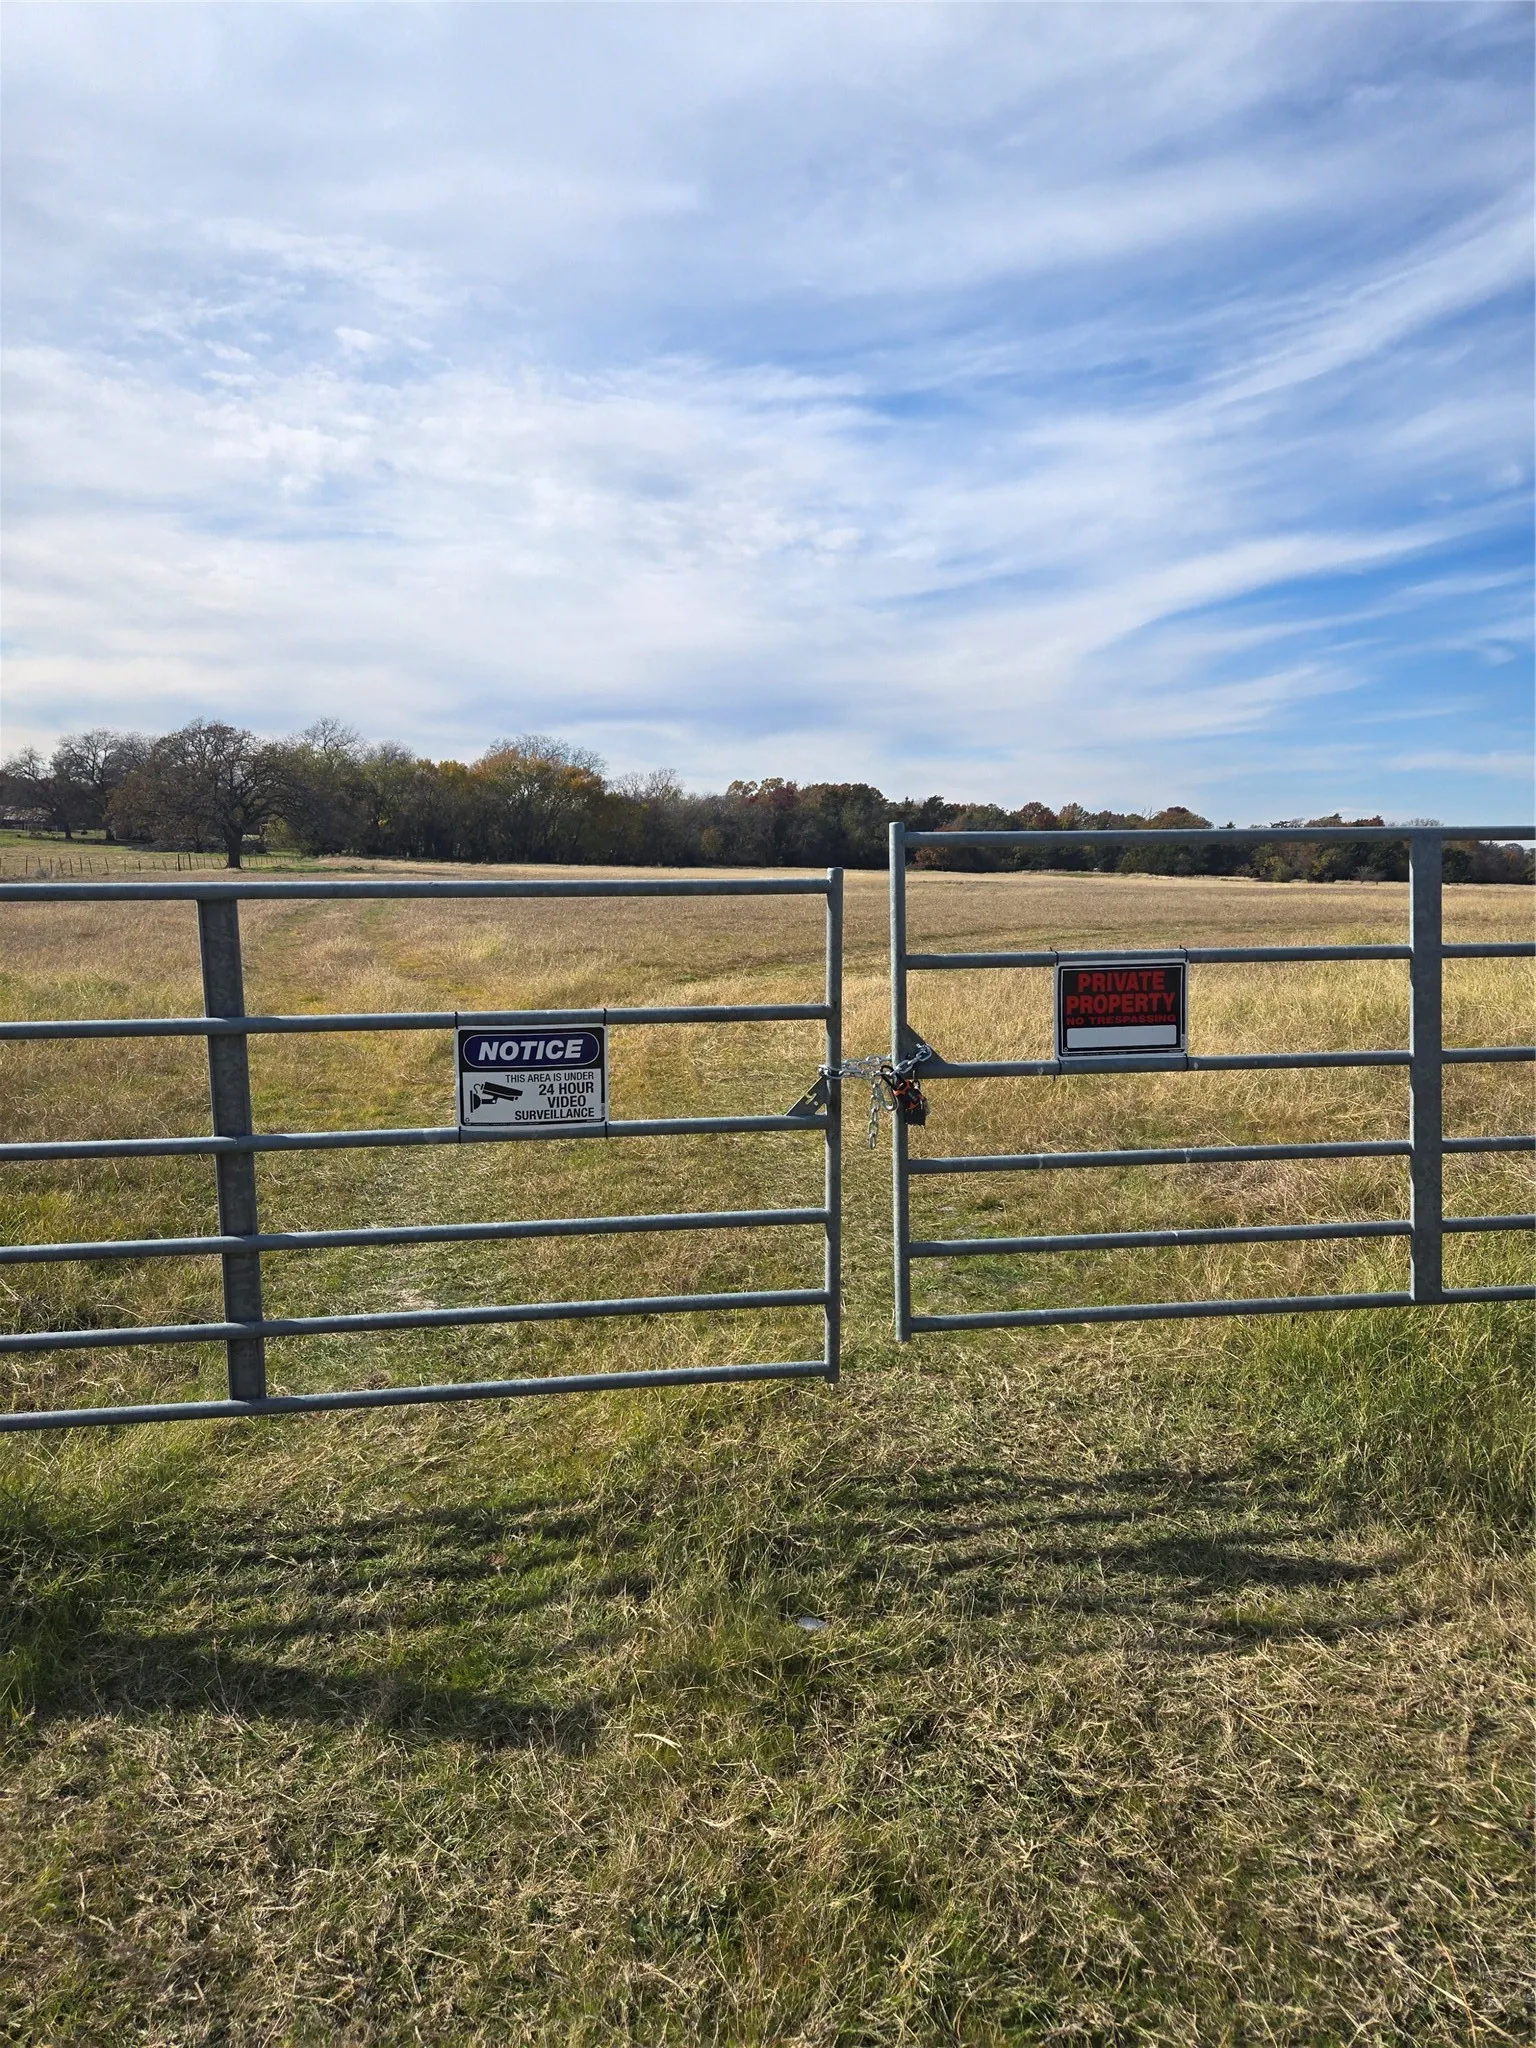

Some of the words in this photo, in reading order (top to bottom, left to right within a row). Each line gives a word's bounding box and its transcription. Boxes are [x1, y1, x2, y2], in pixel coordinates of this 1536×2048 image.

[1078, 971, 1165, 992] PRIVATE
[1066, 992, 1175, 1014] PROPERTY
[1067, 1016, 1085, 1025] NO
[1089, 1014, 1176, 1024] TRESPASSING
[478, 1039, 583, 1061] NOTICE
[505, 1074, 525, 1083] THIS
[527, 1073, 550, 1083] AREA
[553, 1072, 562, 1081] IS
[564, 1071, 594, 1081] UNDER
[538, 1083, 554, 1096] 24
[559, 1082, 594, 1095] HOUR
[547, 1095, 586, 1108] VIDEO
[514, 1108, 595, 1120] SURVEILLANCE
